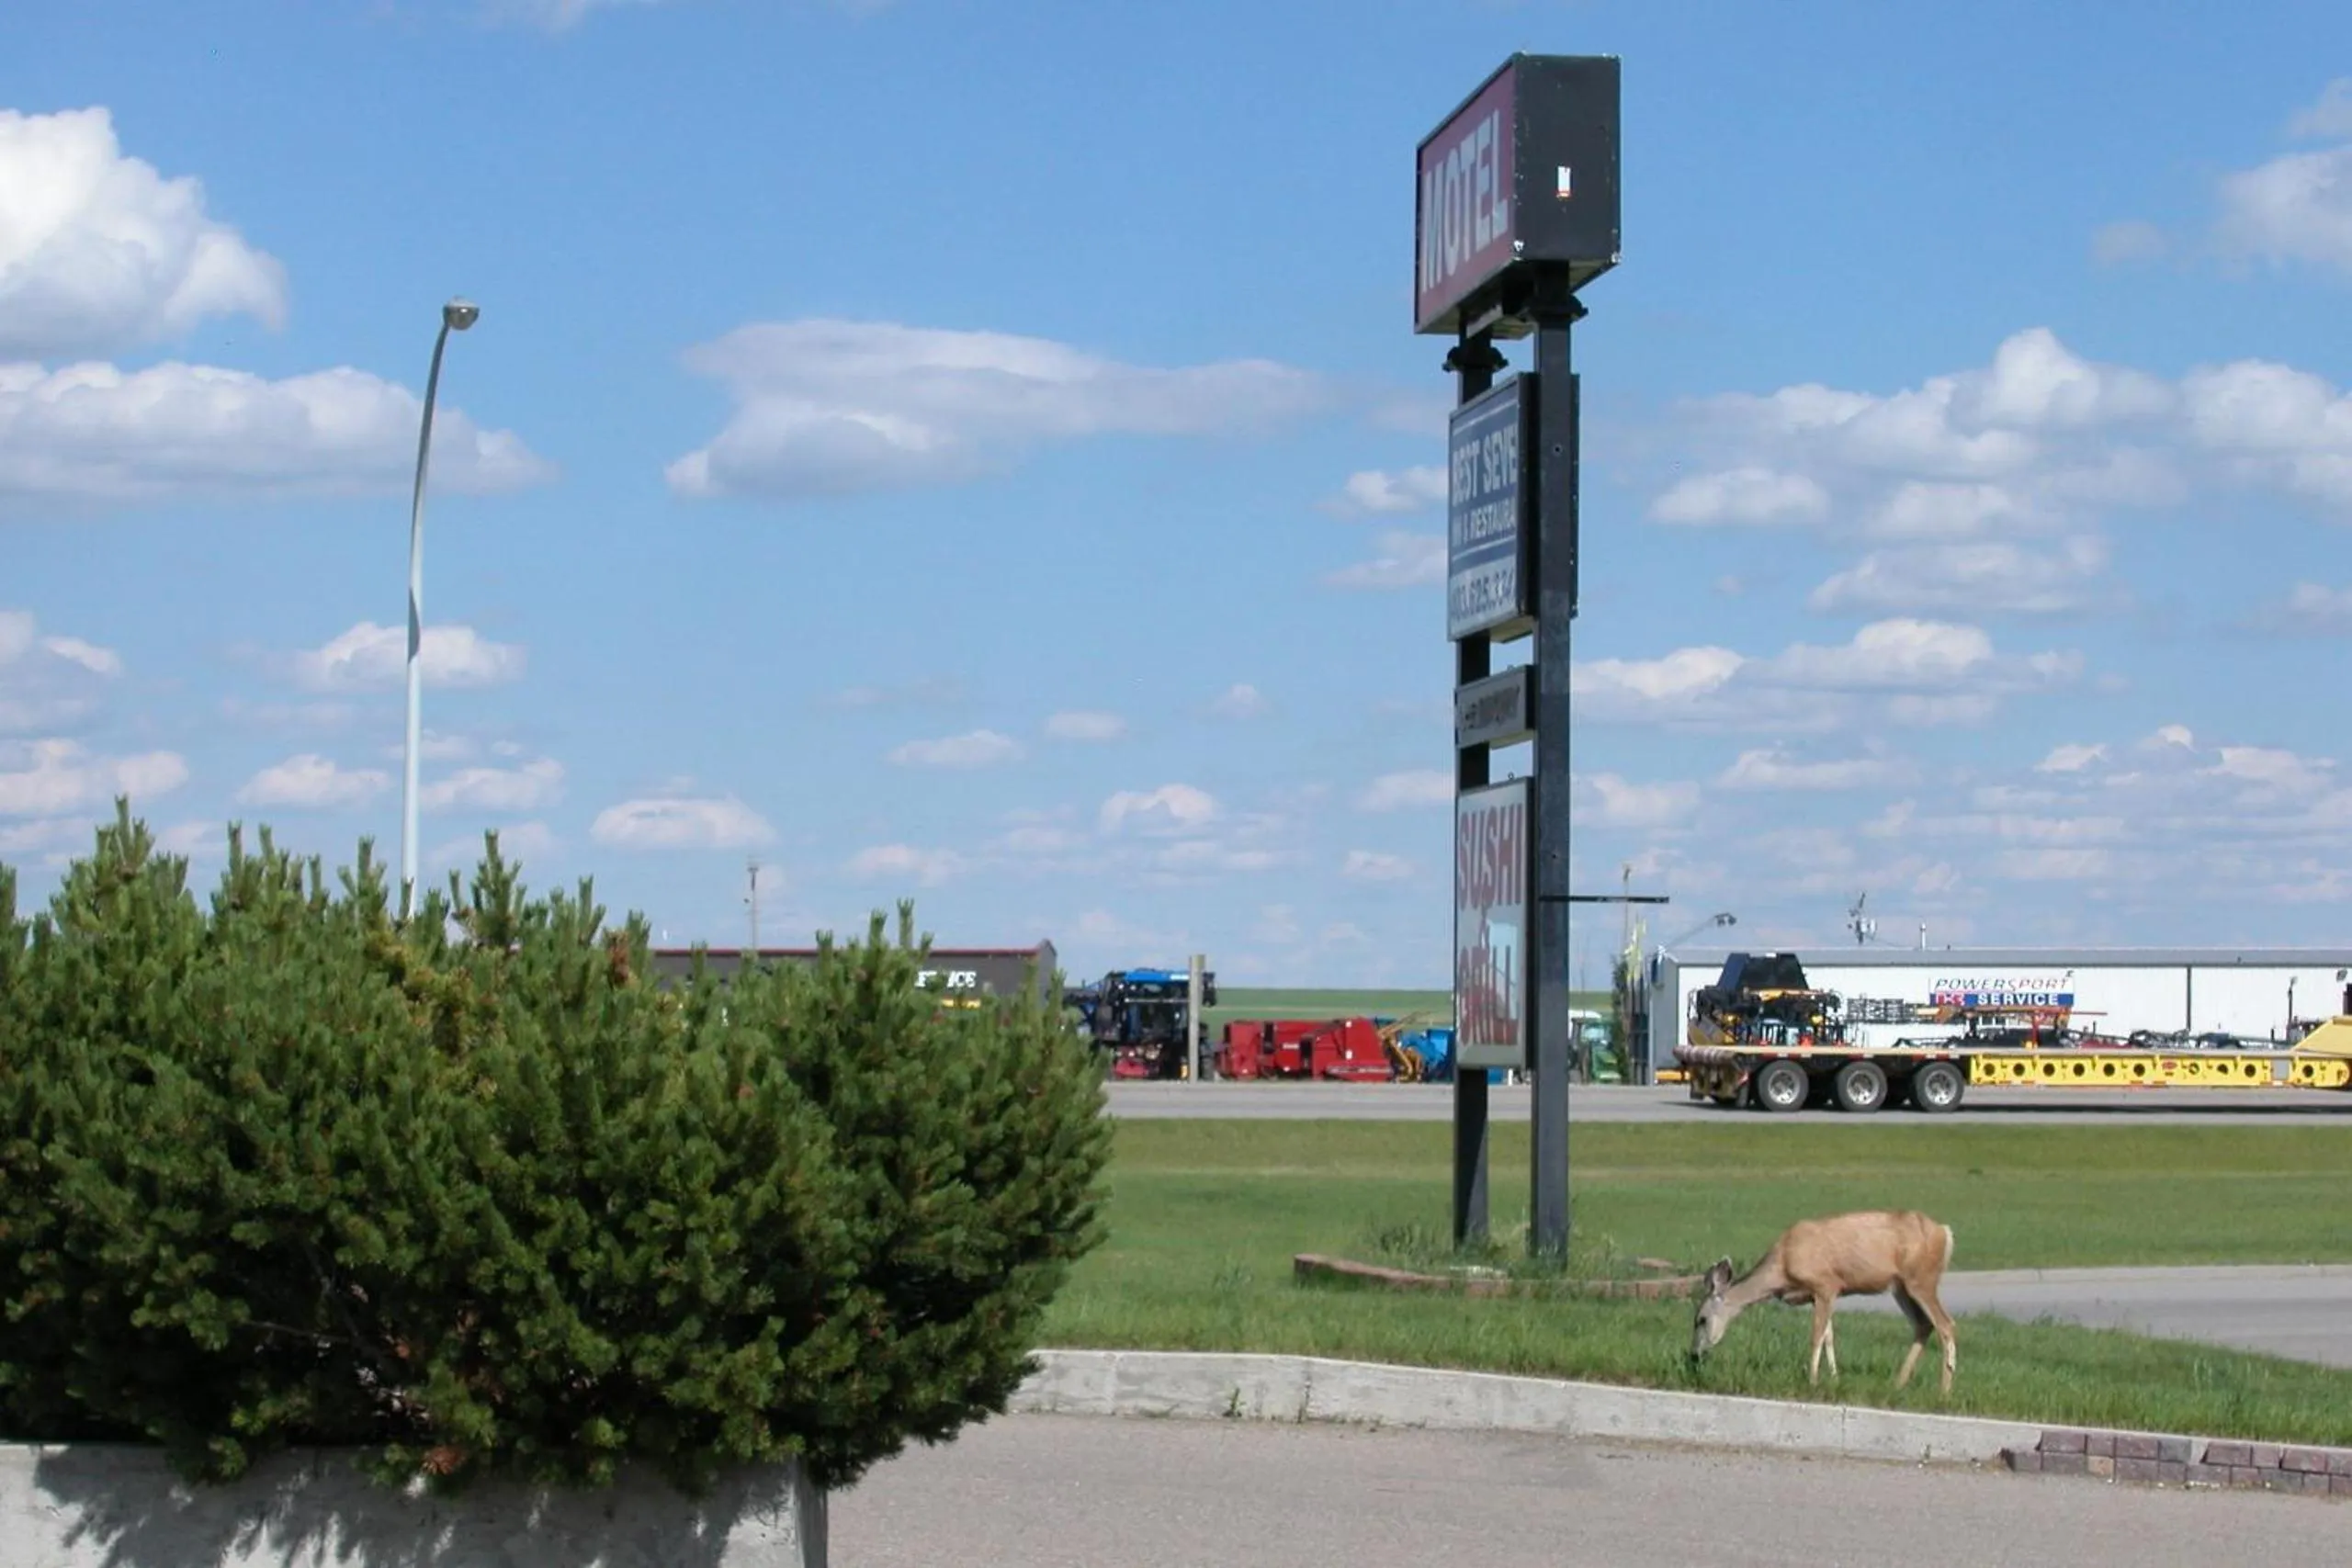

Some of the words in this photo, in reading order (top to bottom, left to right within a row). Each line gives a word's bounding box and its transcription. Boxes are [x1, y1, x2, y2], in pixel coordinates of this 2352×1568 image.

[1422, 108, 1508, 292] MOTEL
[1458, 802, 1522, 911] SUSHI
[1458, 944, 1518, 1046] GRILL
[1934, 977, 2068, 992] POWERSPORT
[1977, 992, 2058, 1006] SERVICE
